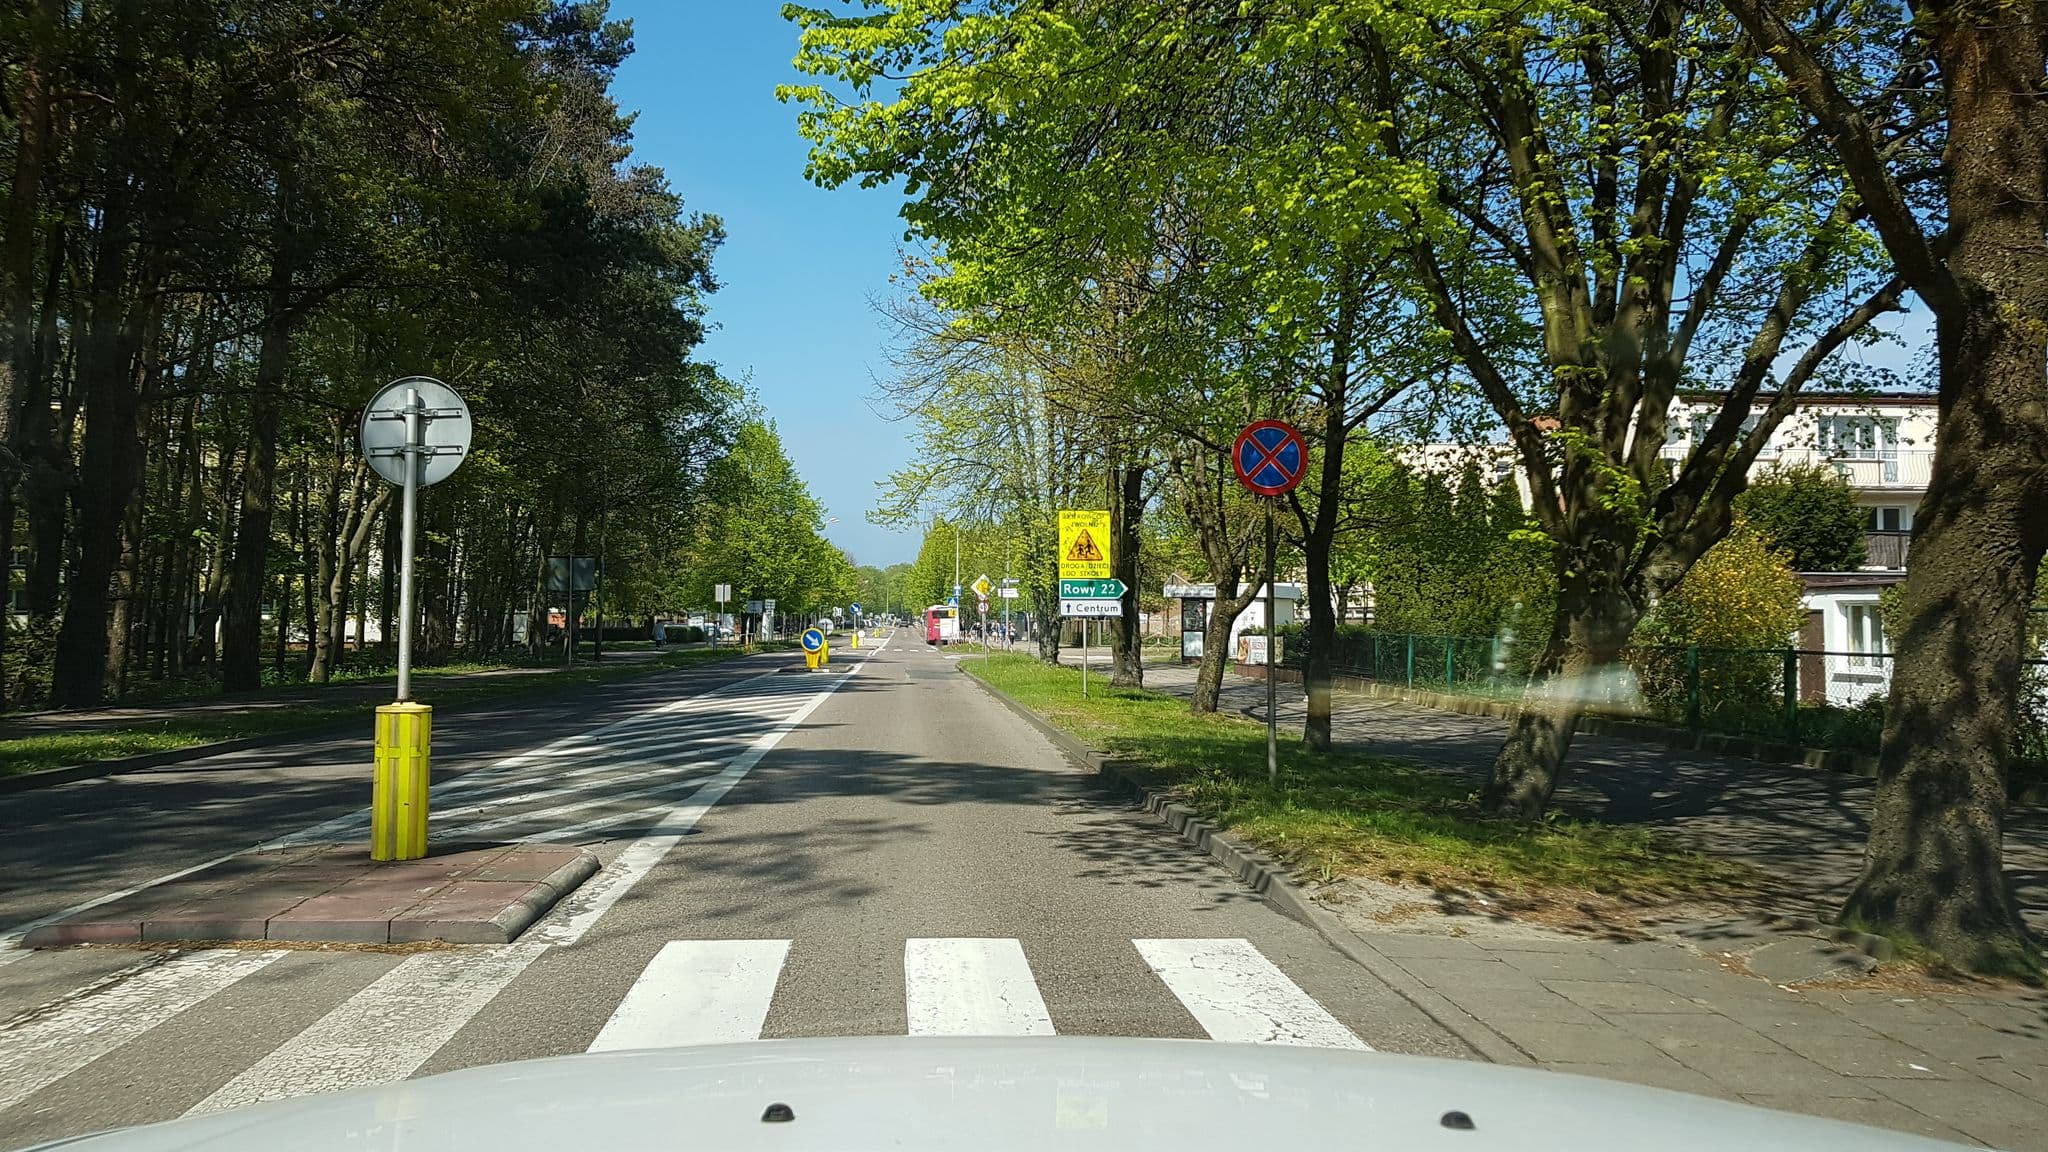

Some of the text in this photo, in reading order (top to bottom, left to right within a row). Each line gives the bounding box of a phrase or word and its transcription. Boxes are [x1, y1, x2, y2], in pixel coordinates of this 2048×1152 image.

[1063, 584, 1116, 597] Rowy 22
[1076, 603, 1119, 613] Centrum
